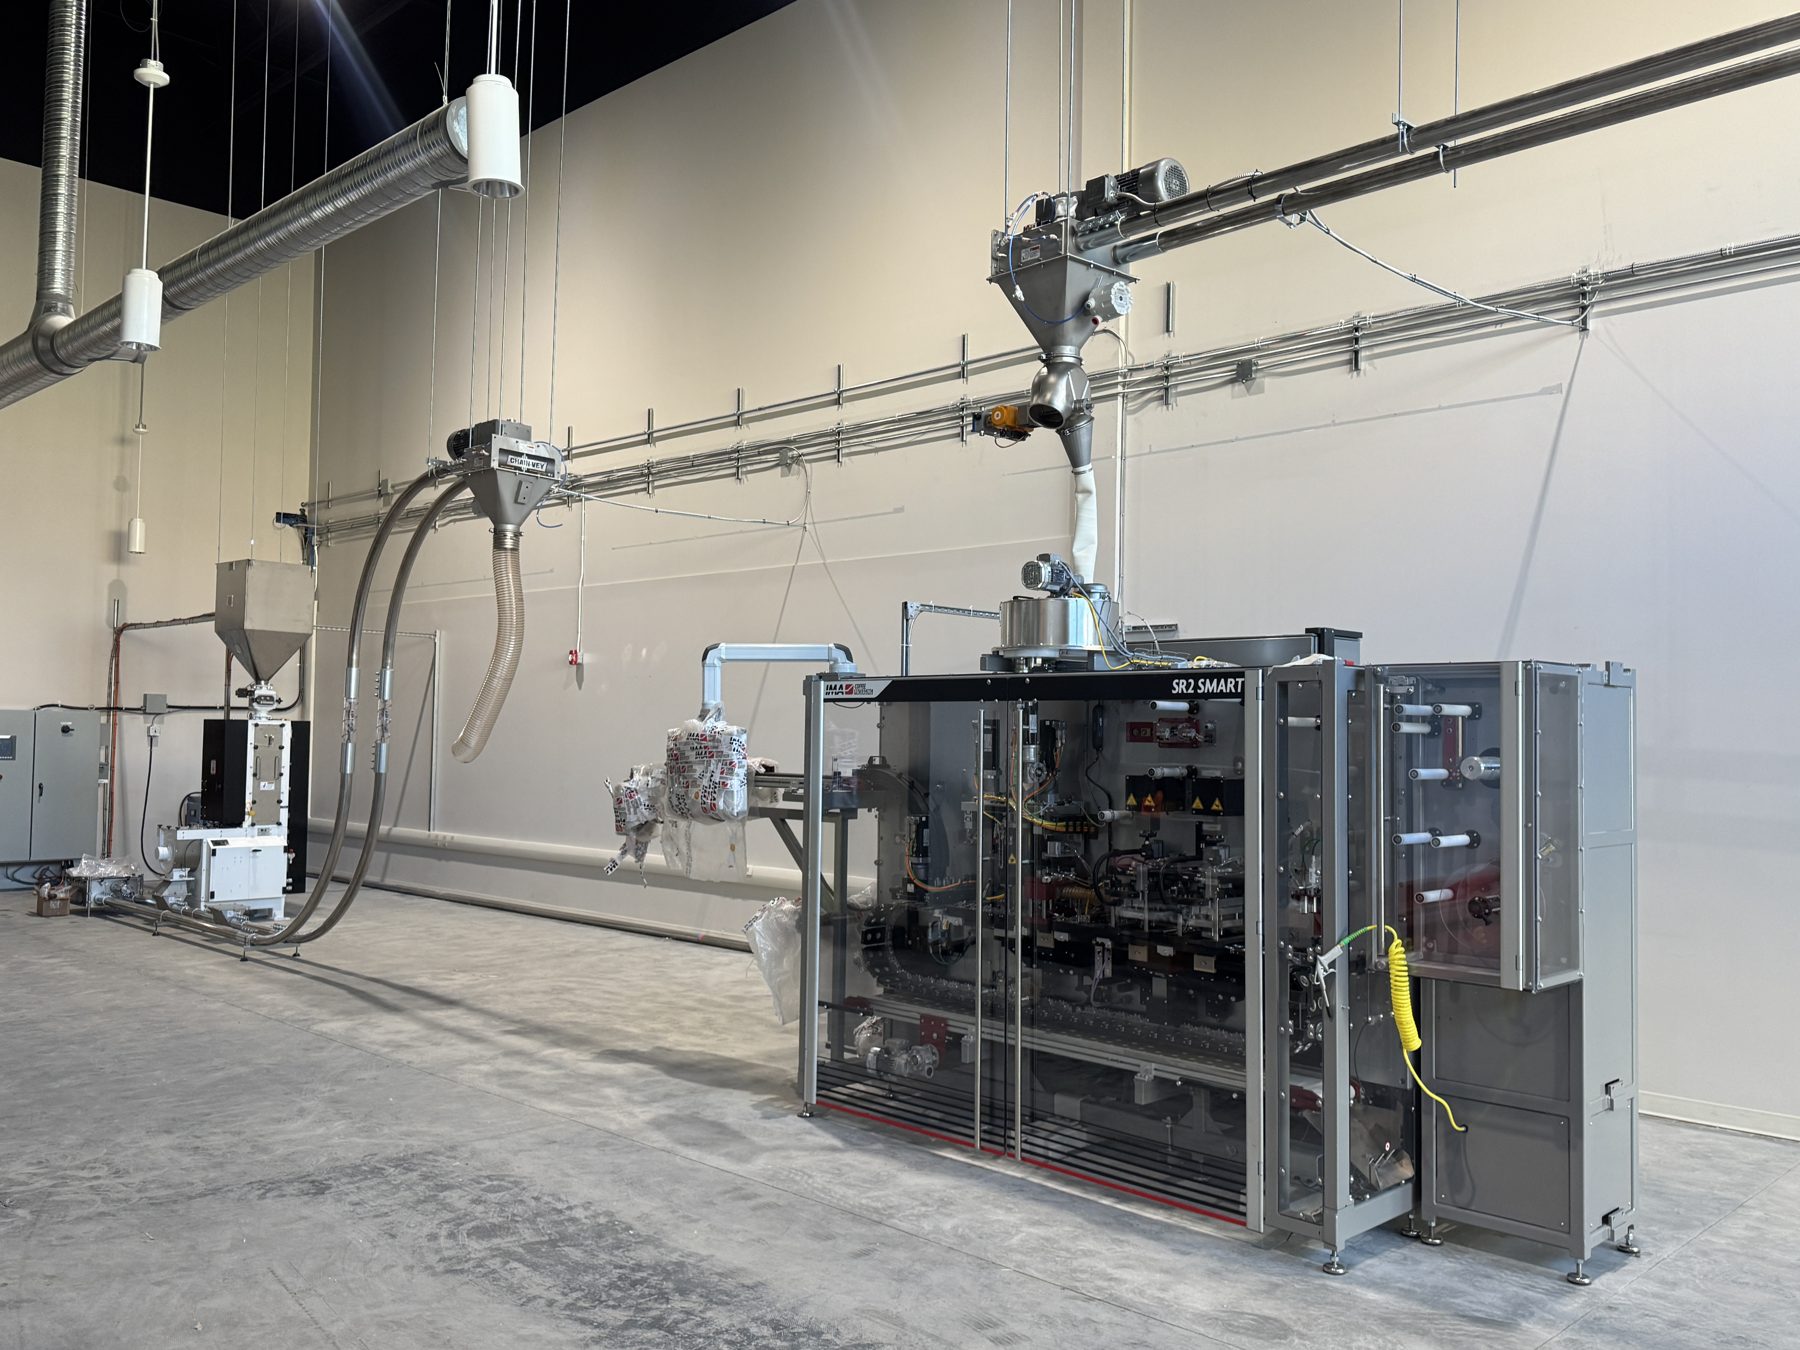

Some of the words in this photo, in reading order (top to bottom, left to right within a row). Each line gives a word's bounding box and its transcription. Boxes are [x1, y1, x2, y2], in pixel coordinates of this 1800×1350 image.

[825, 683, 845, 696] IMA
[1171, 678, 1195, 694] SR2
[1197, 677, 1245, 693] SMART
